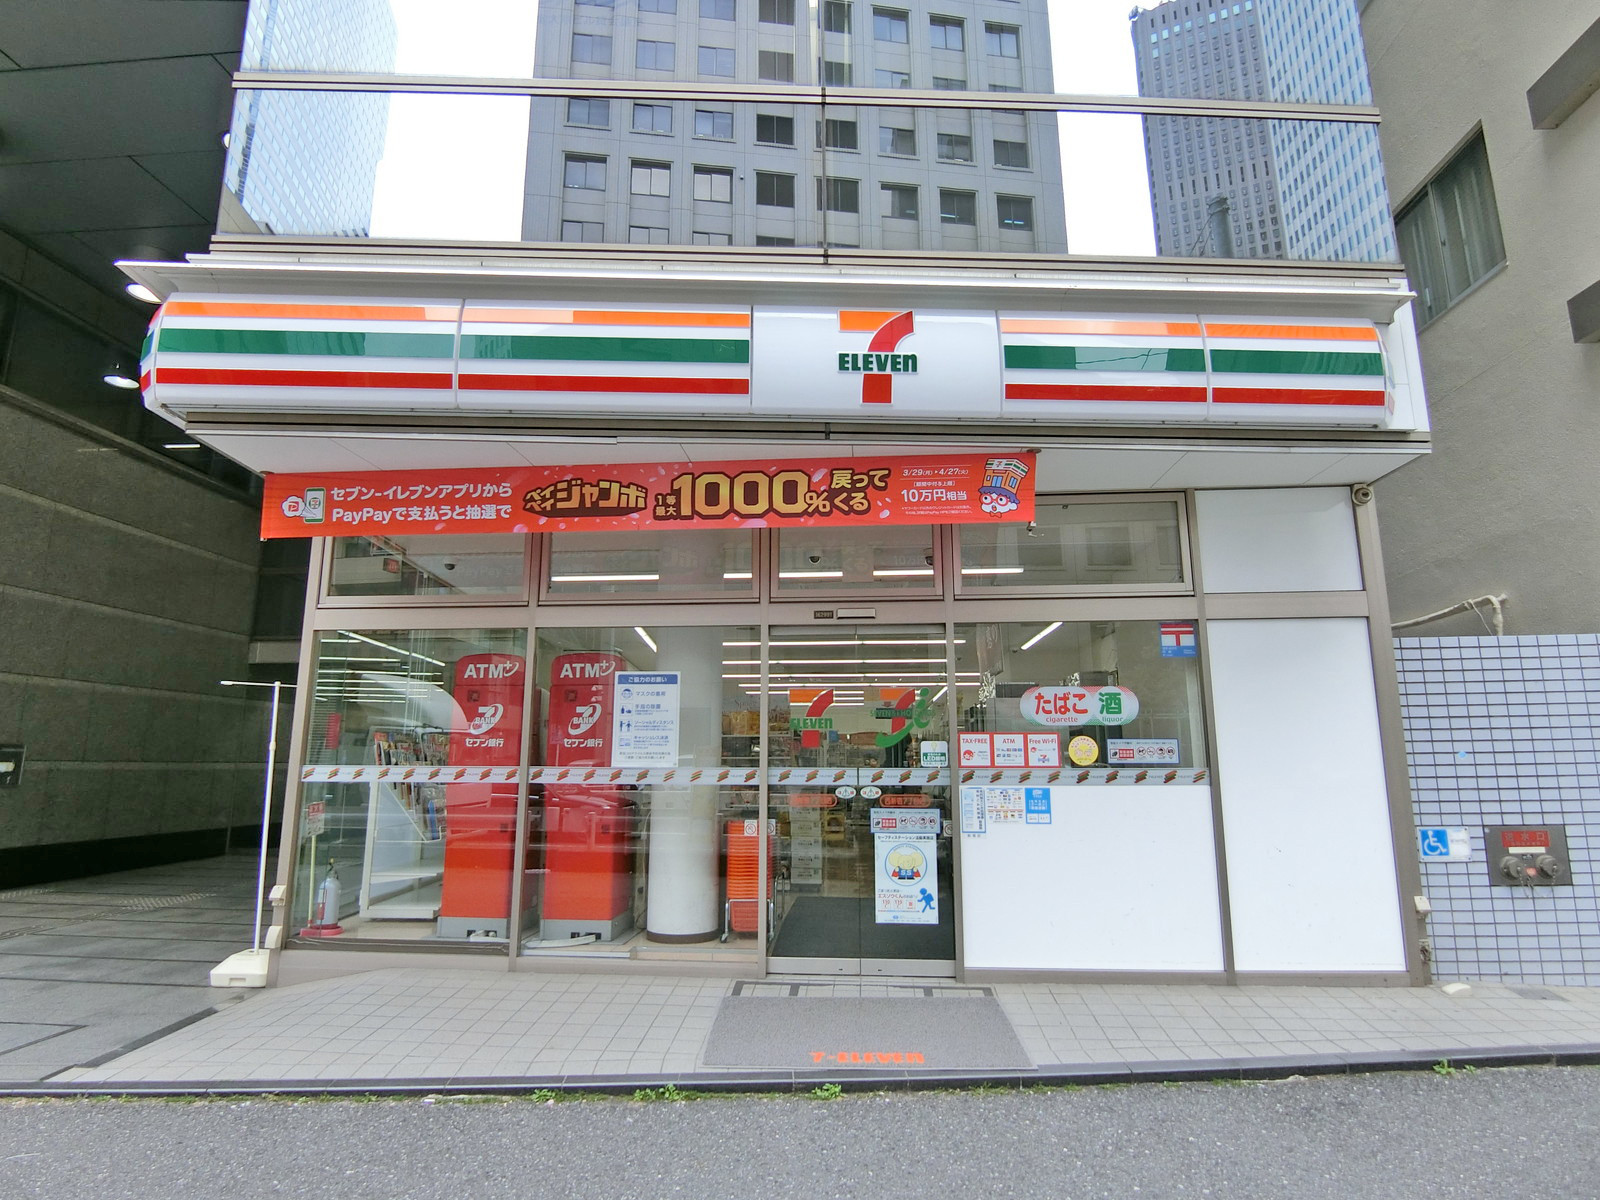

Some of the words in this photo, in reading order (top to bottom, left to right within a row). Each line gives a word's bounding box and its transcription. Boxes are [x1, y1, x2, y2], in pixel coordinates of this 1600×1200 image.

[831, 469, 889, 489] 戻って
[331, 483, 512, 501] セブン-イレブンアプリから
[657, 495, 676, 505] 1等
[901, 489, 967, 502] 10万円相当
[834, 492, 869, 511] くる
[332, 505, 512, 524] PayPayで支払うと抽選で
[655, 506, 677, 516] 最大
[1035, 692, 1088, 715] たばこ
[1099, 692, 1122, 715] 酒
[465, 738, 504, 748] セブン銀行
[564, 738, 603, 748] セブン銀行
